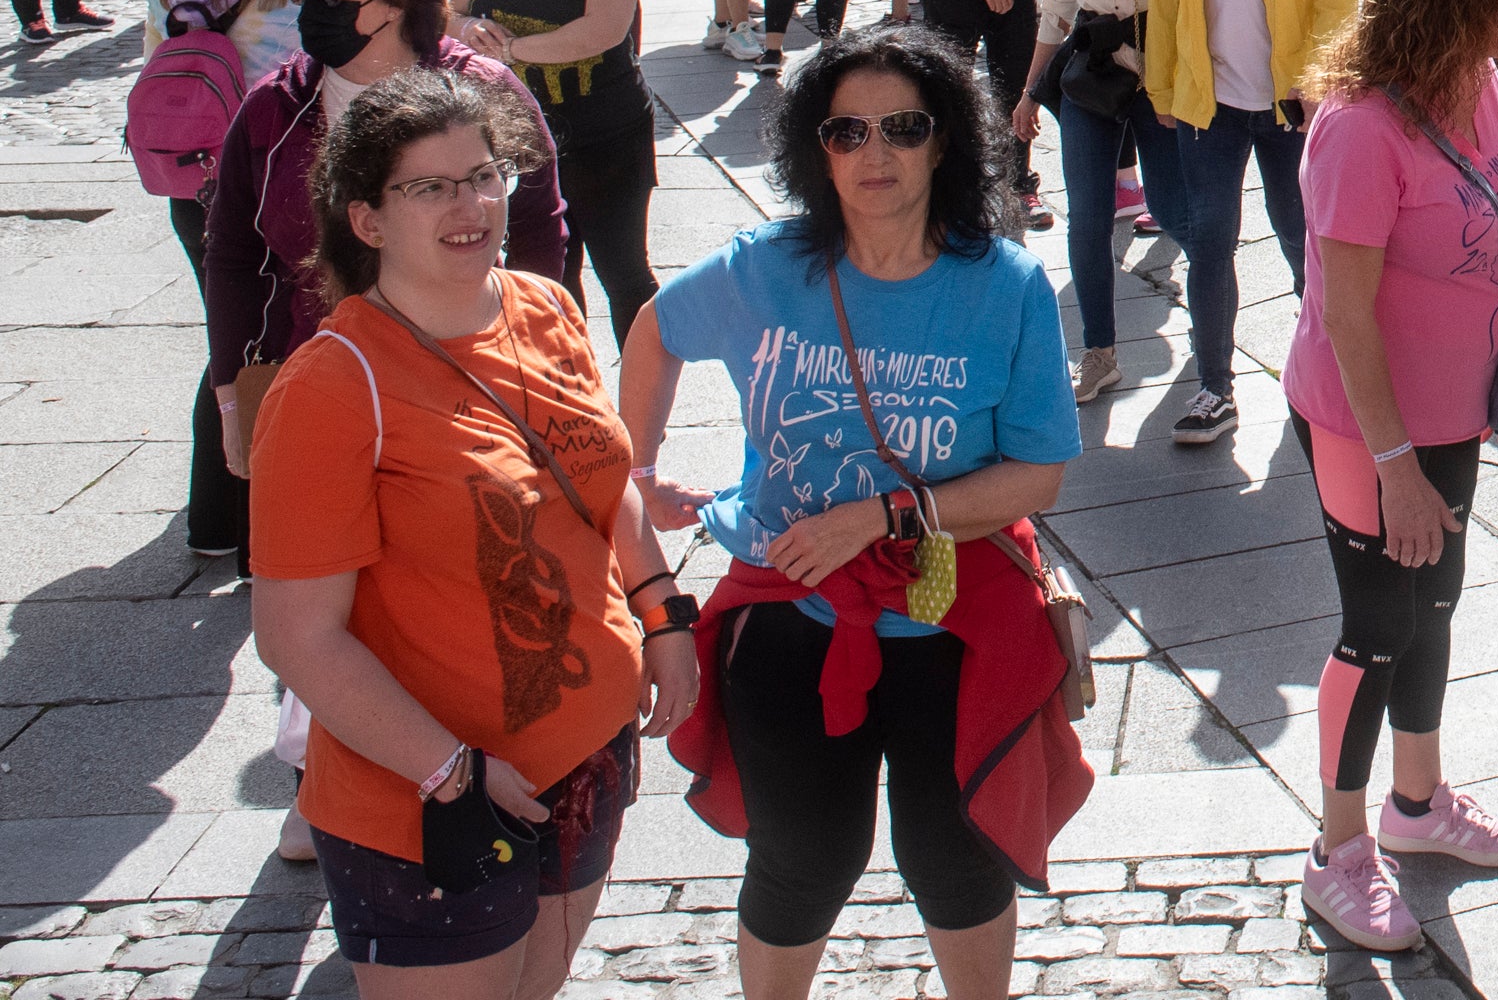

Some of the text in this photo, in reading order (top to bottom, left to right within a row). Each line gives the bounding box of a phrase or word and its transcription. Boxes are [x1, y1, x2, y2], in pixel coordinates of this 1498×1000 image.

[886, 351, 969, 391] MUJERES
[568, 452, 618, 484] Segovia
[1348, 538, 1366, 551] MVX
[1434, 600, 1451, 609] MVX
[1341, 644, 1357, 657] MVX
[1372, 653, 1392, 664] MVX
